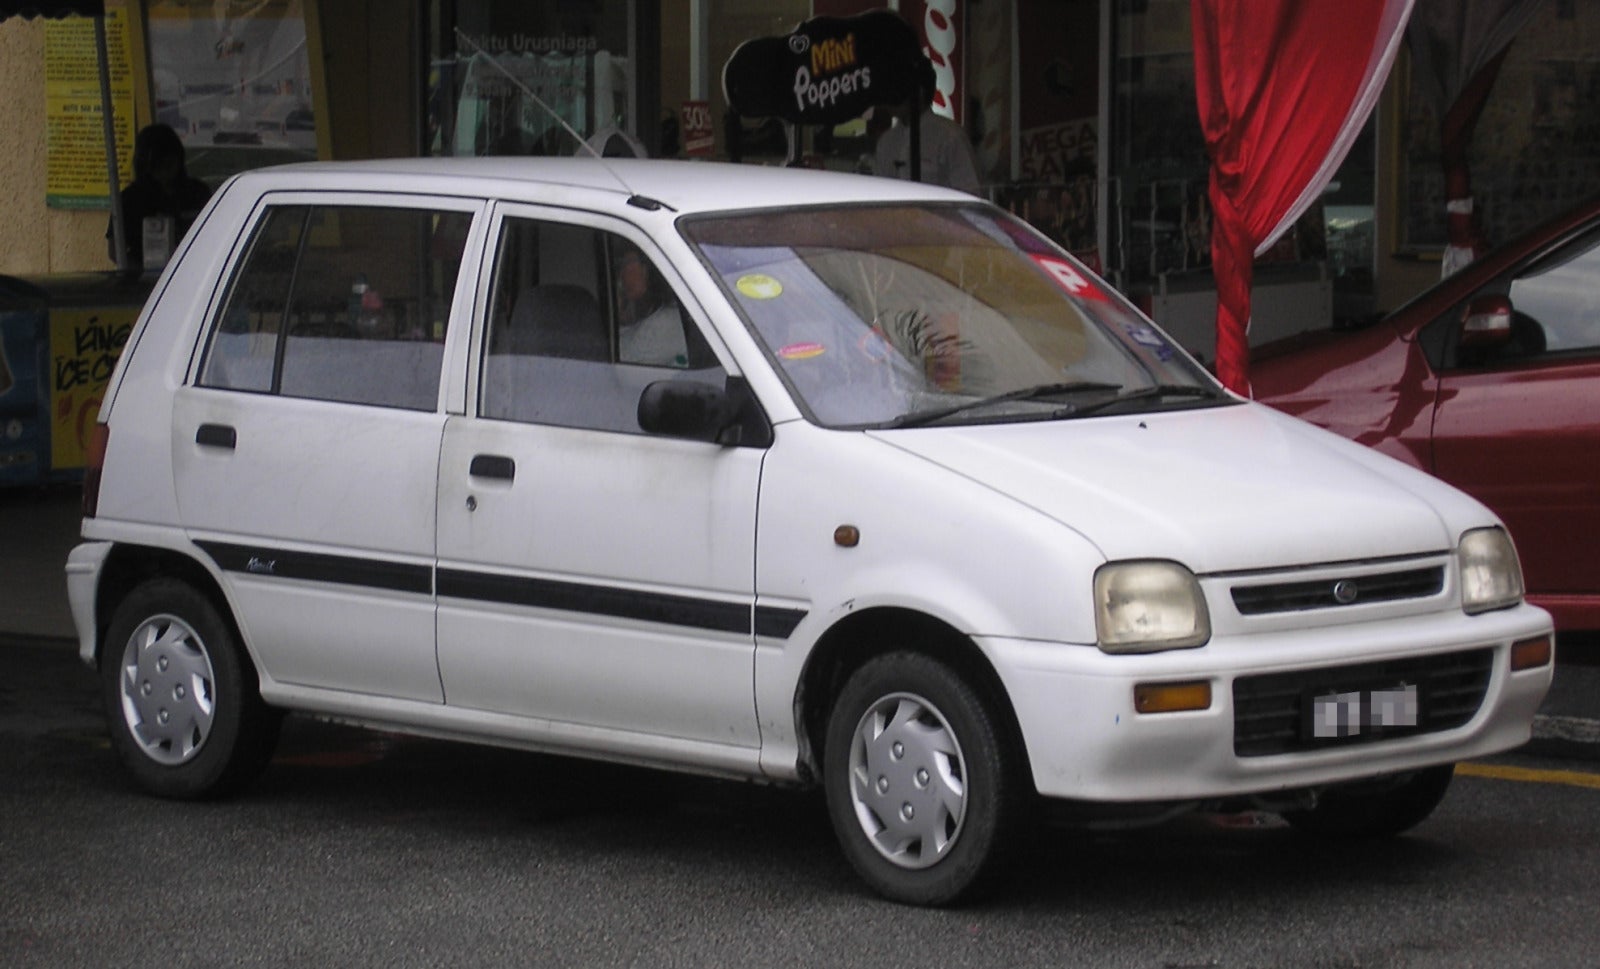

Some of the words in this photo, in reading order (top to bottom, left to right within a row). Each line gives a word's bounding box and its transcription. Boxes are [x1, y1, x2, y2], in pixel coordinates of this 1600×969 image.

[513, 32, 597, 53] Urusniaga
[794, 65, 871, 111] Poppers
[683, 106, 713, 130] 30%
[1020, 124, 1097, 157] MEGA
